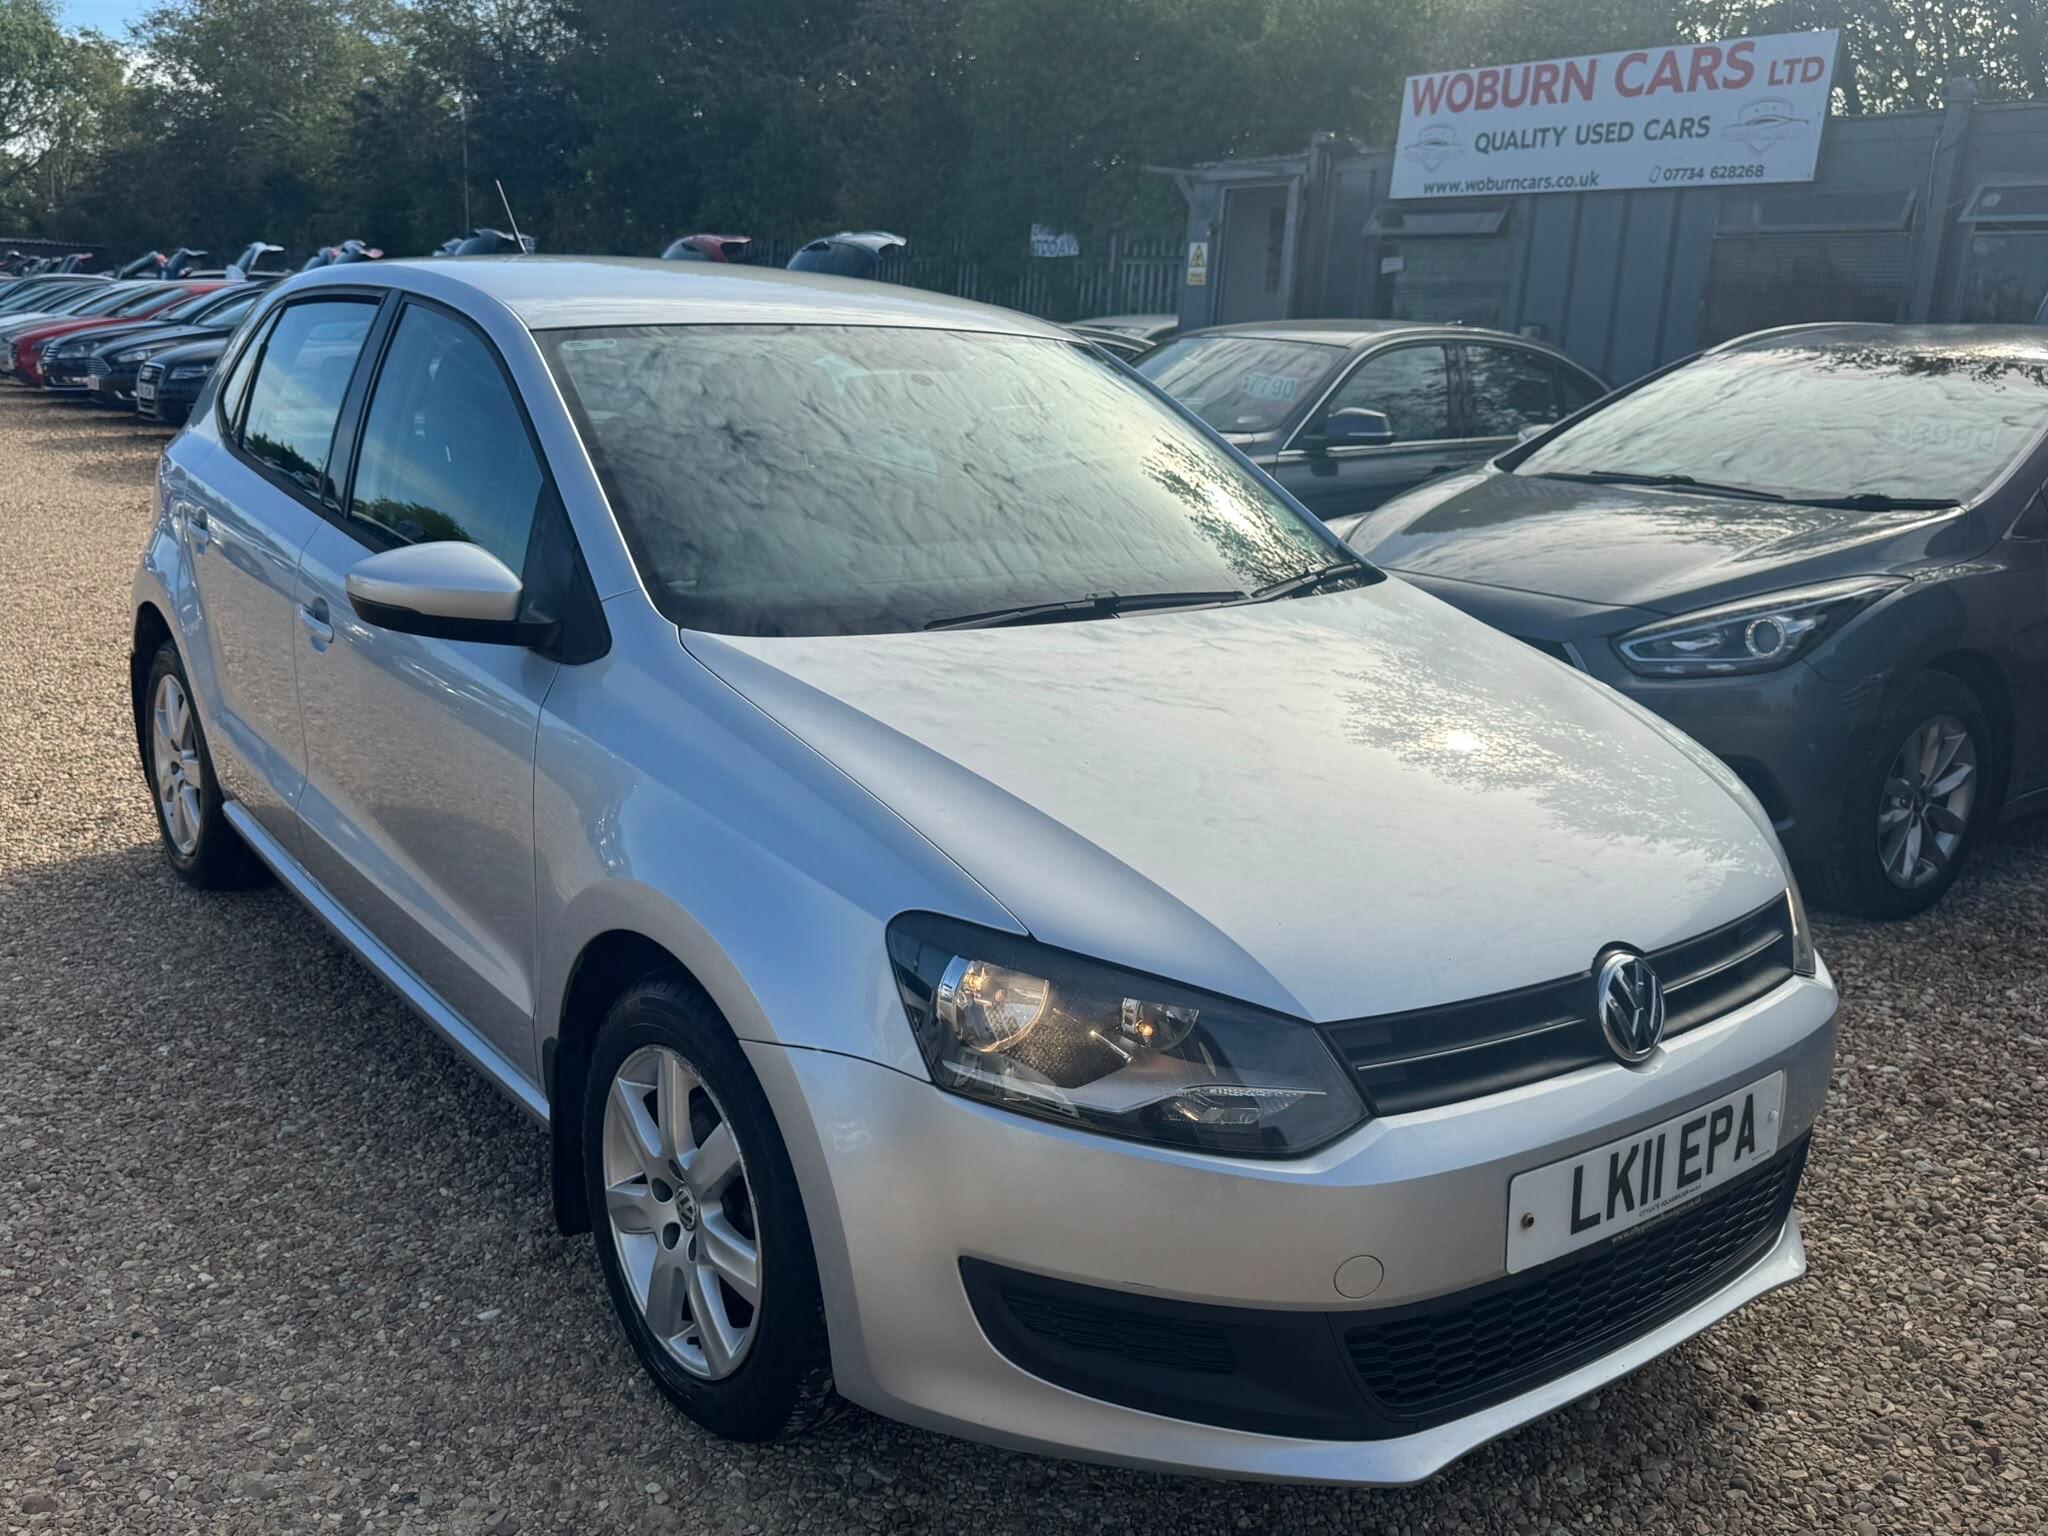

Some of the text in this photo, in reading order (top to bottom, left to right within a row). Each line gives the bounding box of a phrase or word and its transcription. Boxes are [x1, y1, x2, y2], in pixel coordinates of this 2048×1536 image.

[1411, 41, 1825, 117] WOBURN CARS LTD
[1474, 125, 1567, 154] QUALITY
[1575, 121, 1635, 146] USED
[1643, 115, 1711, 141] CARS
[1423, 170, 1600, 195] www.woburncars.co.uk
[1663, 164, 1765, 181] 07734 628268
[1570, 1133, 1665, 1235] LK11
[1677, 1093, 1755, 1189] EPA
